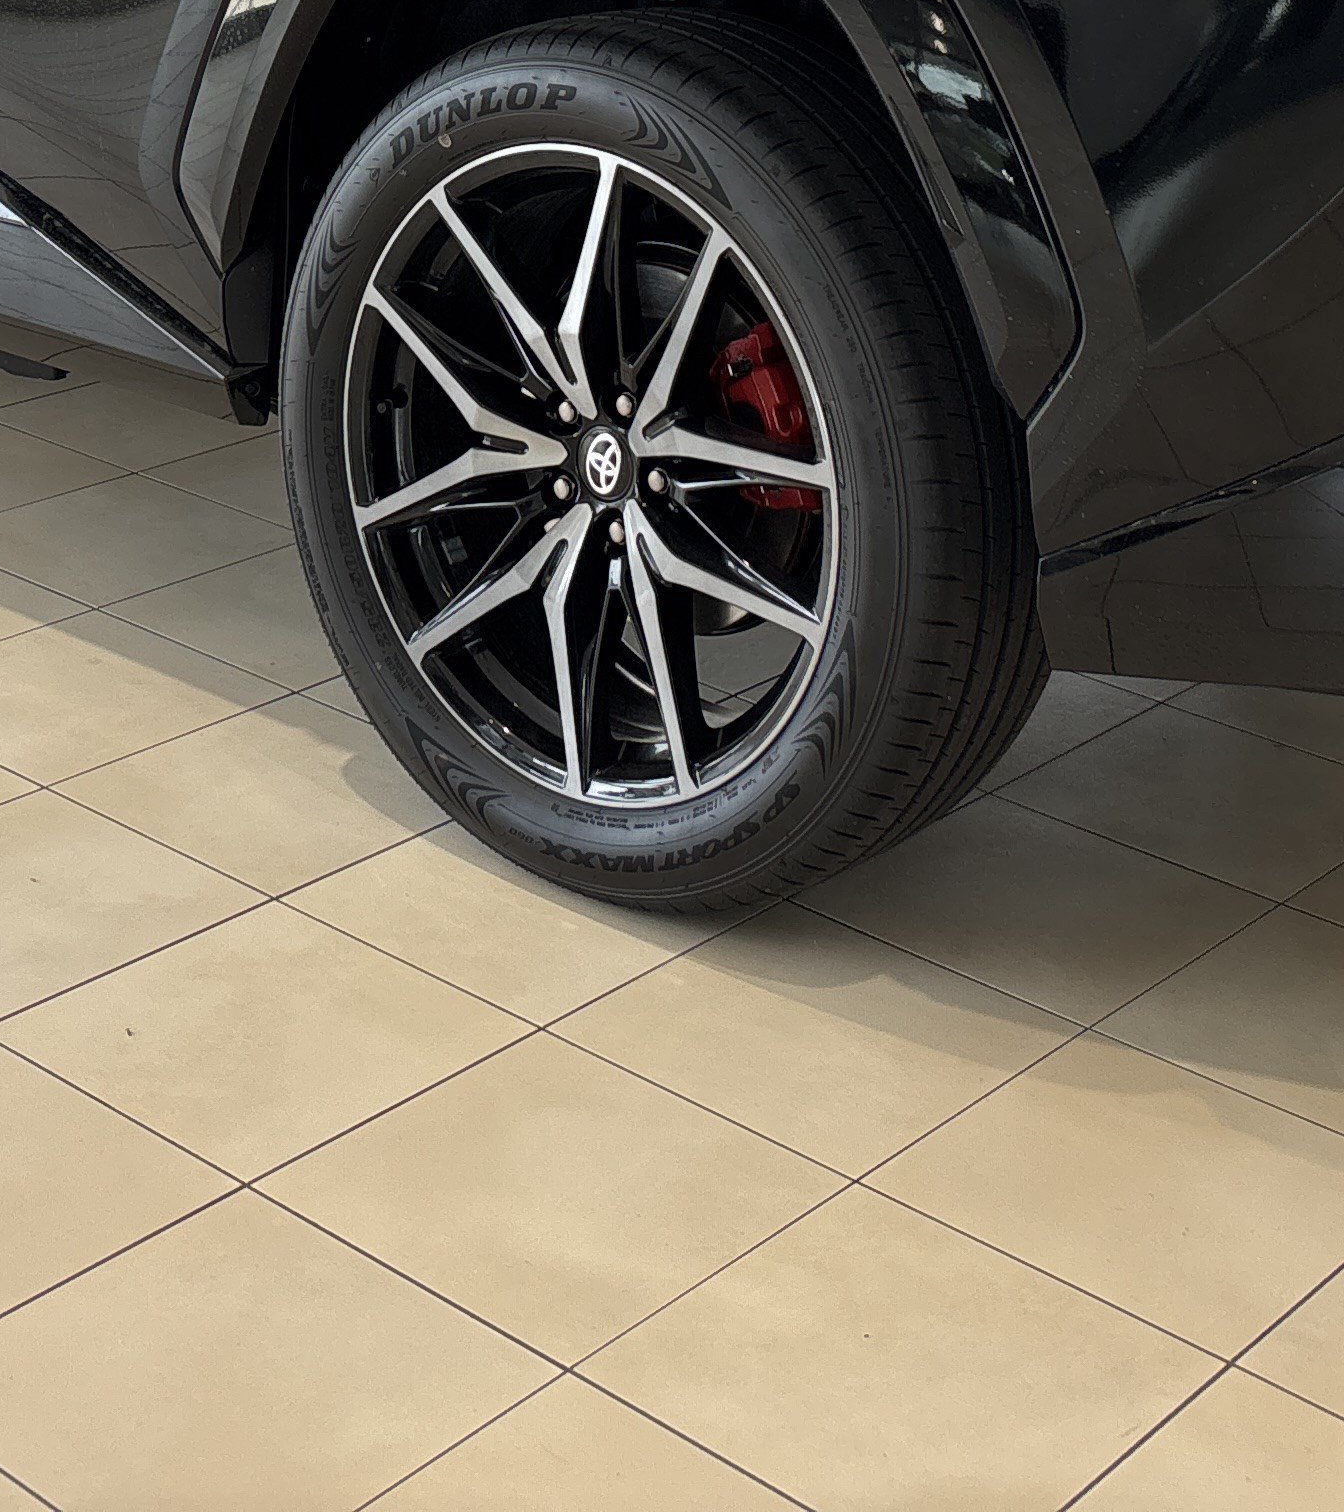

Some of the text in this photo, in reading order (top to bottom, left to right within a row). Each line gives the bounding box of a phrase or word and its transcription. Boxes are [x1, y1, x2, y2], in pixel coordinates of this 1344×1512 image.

[389, 81, 578, 170] DUNLOP
[540, 836, 655, 873] MAXX
[657, 815, 761, 872] SPORT
